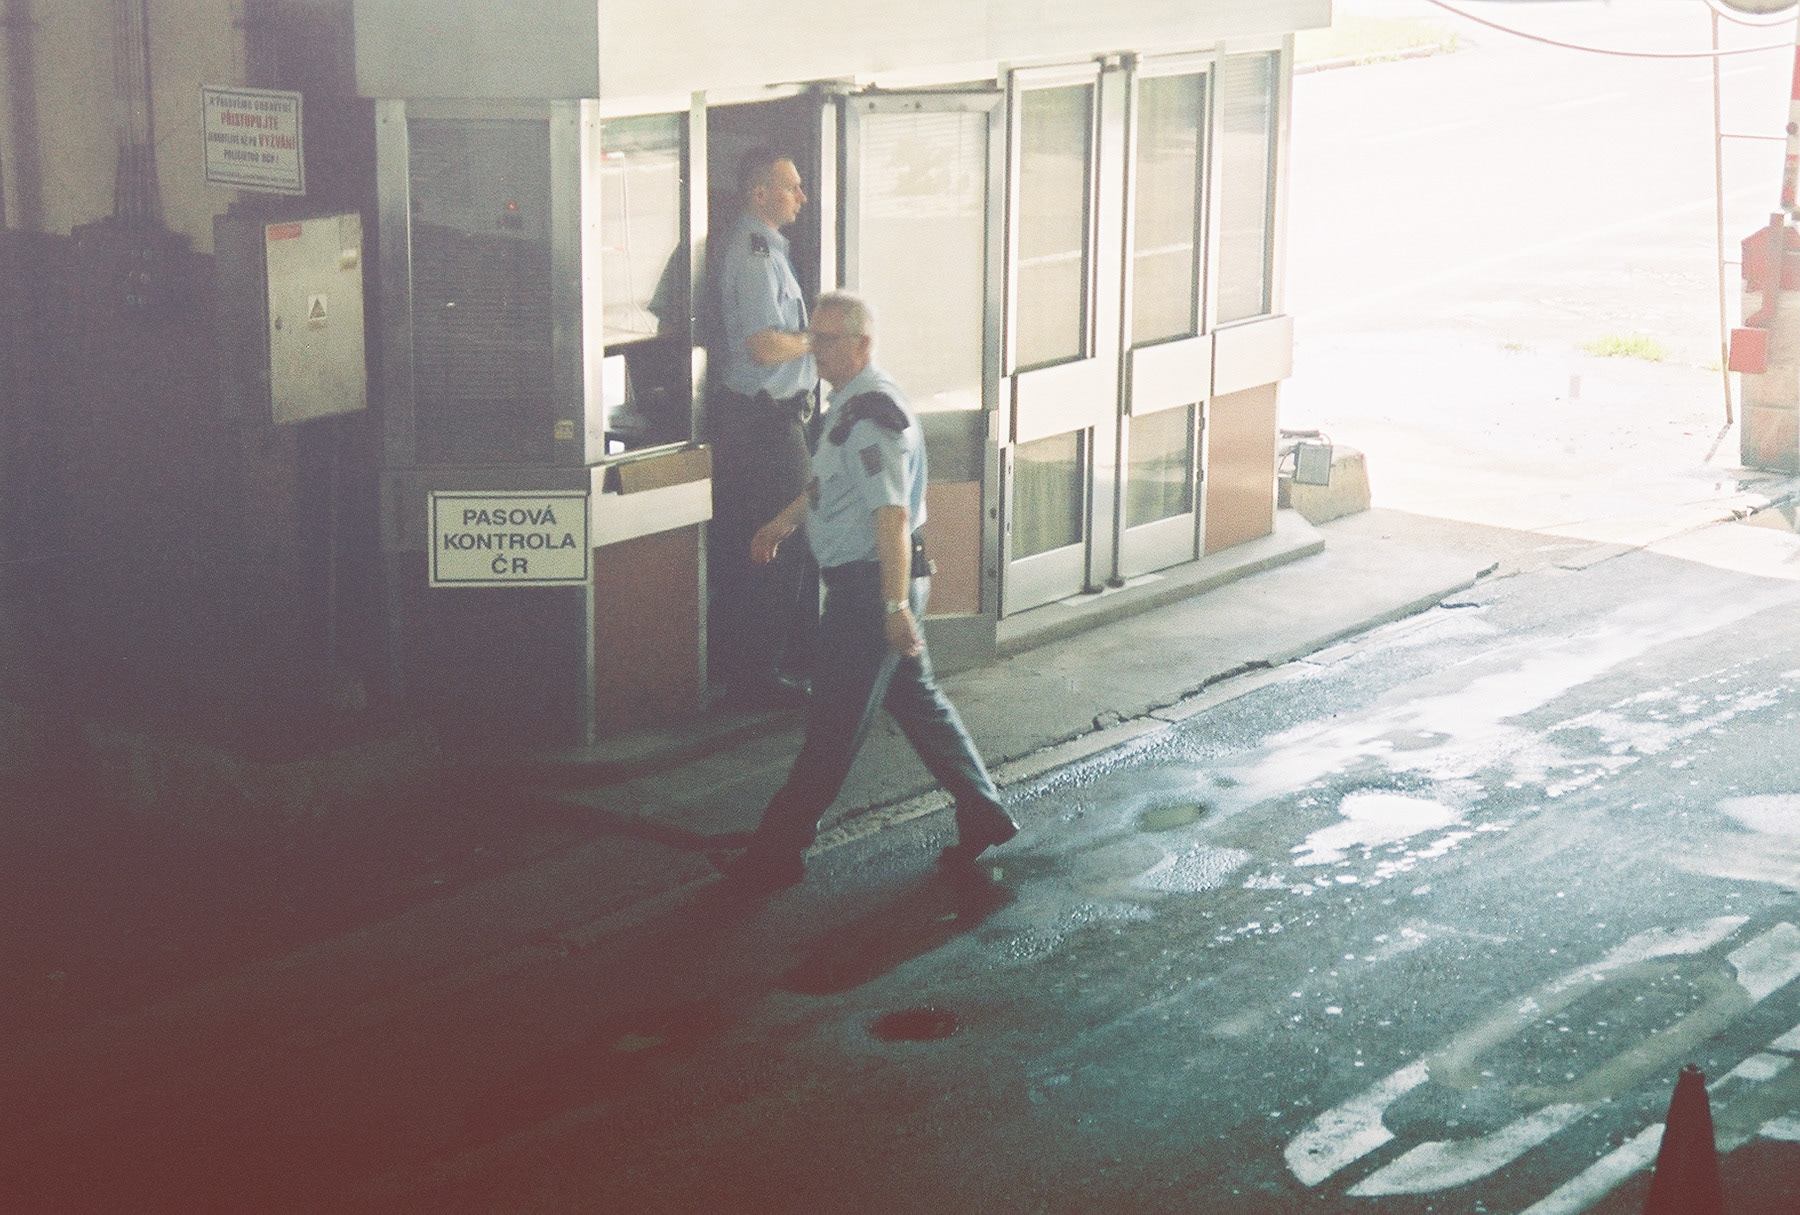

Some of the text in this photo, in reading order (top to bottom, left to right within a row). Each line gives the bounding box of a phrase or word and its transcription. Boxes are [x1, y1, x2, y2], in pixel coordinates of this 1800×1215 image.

[221, 110, 278, 130] PŘISTUPUJTE
[463, 504, 557, 526] PASOVÁ
[444, 533, 576, 549] KONTROLA
[491, 553, 528, 574] ČR
